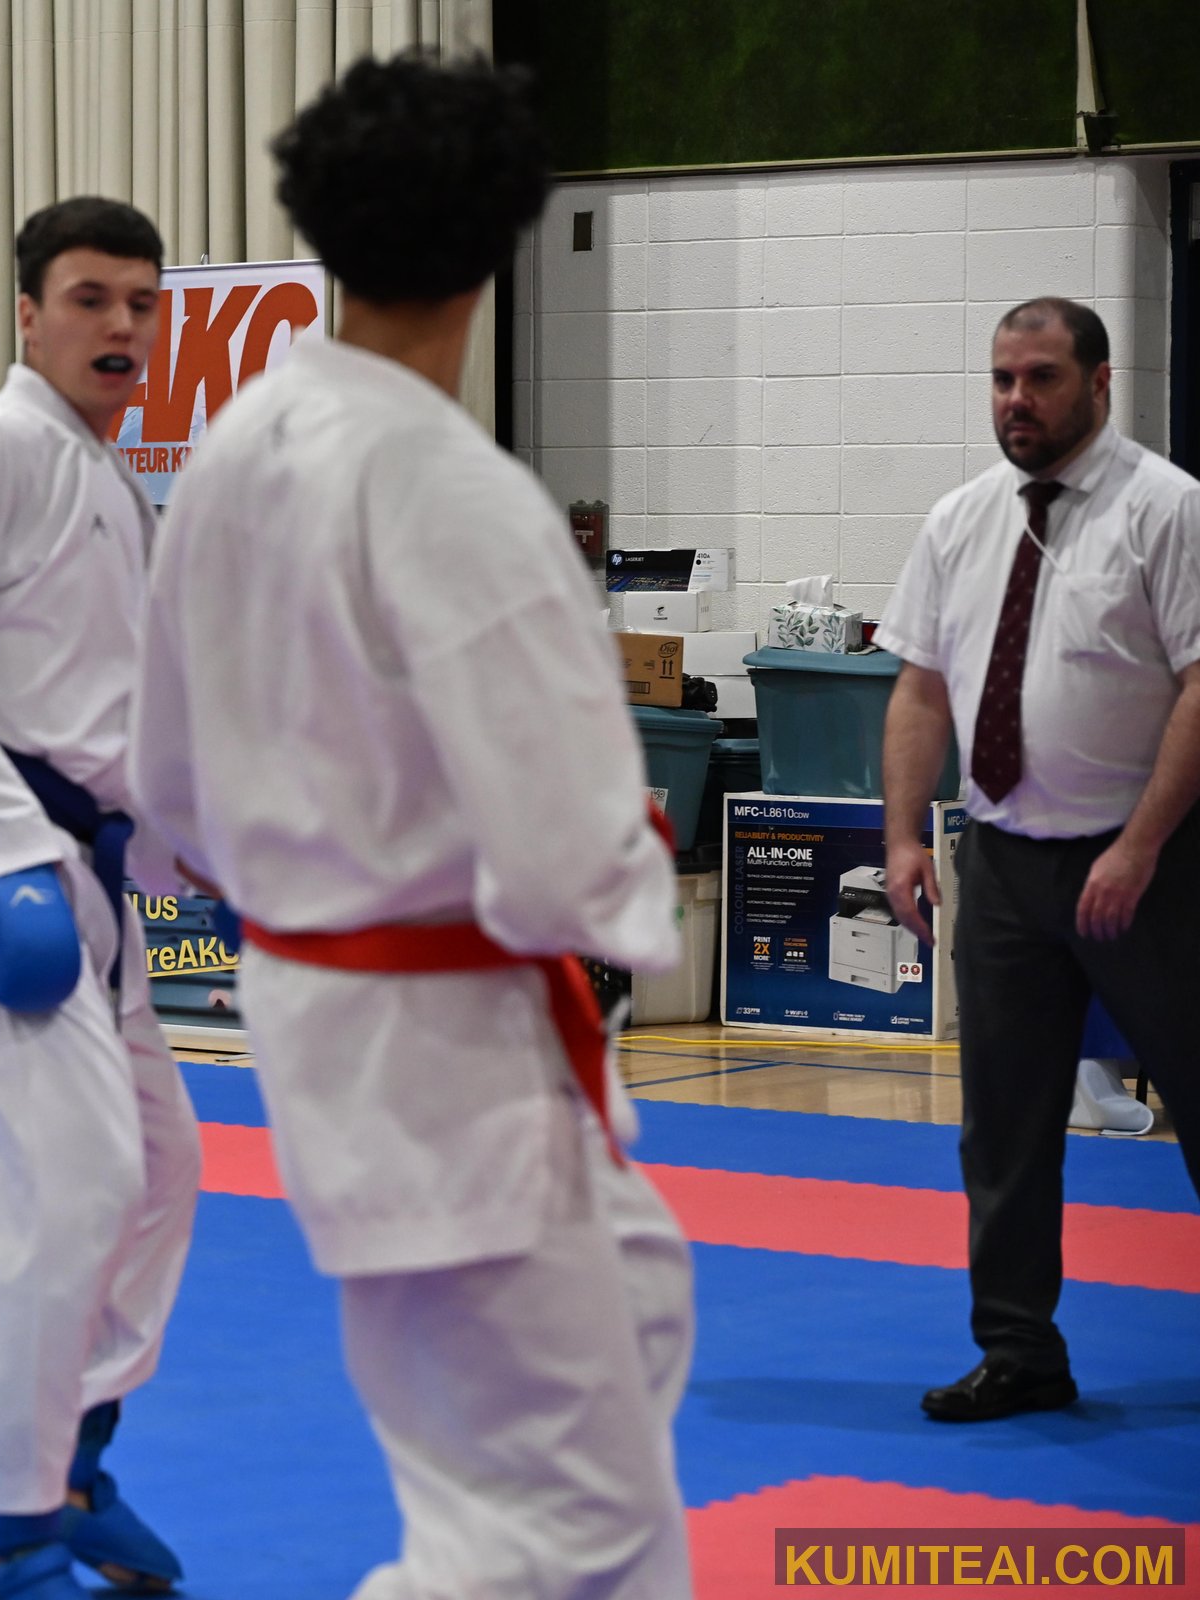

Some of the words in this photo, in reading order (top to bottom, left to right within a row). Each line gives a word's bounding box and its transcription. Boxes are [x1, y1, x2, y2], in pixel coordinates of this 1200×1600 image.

[777, 833, 825, 842] PRODUCTIVITY
[747, 846, 813, 861] ALL-IN-ONE
[747, 858, 790, 866] Multi-Function
[790, 860, 813, 868] Centre
[145, 895, 179, 921] US
[734, 884, 744, 935] COLOUR
[753, 935, 771, 943] PRINT
[753, 942, 770, 955] 2X
